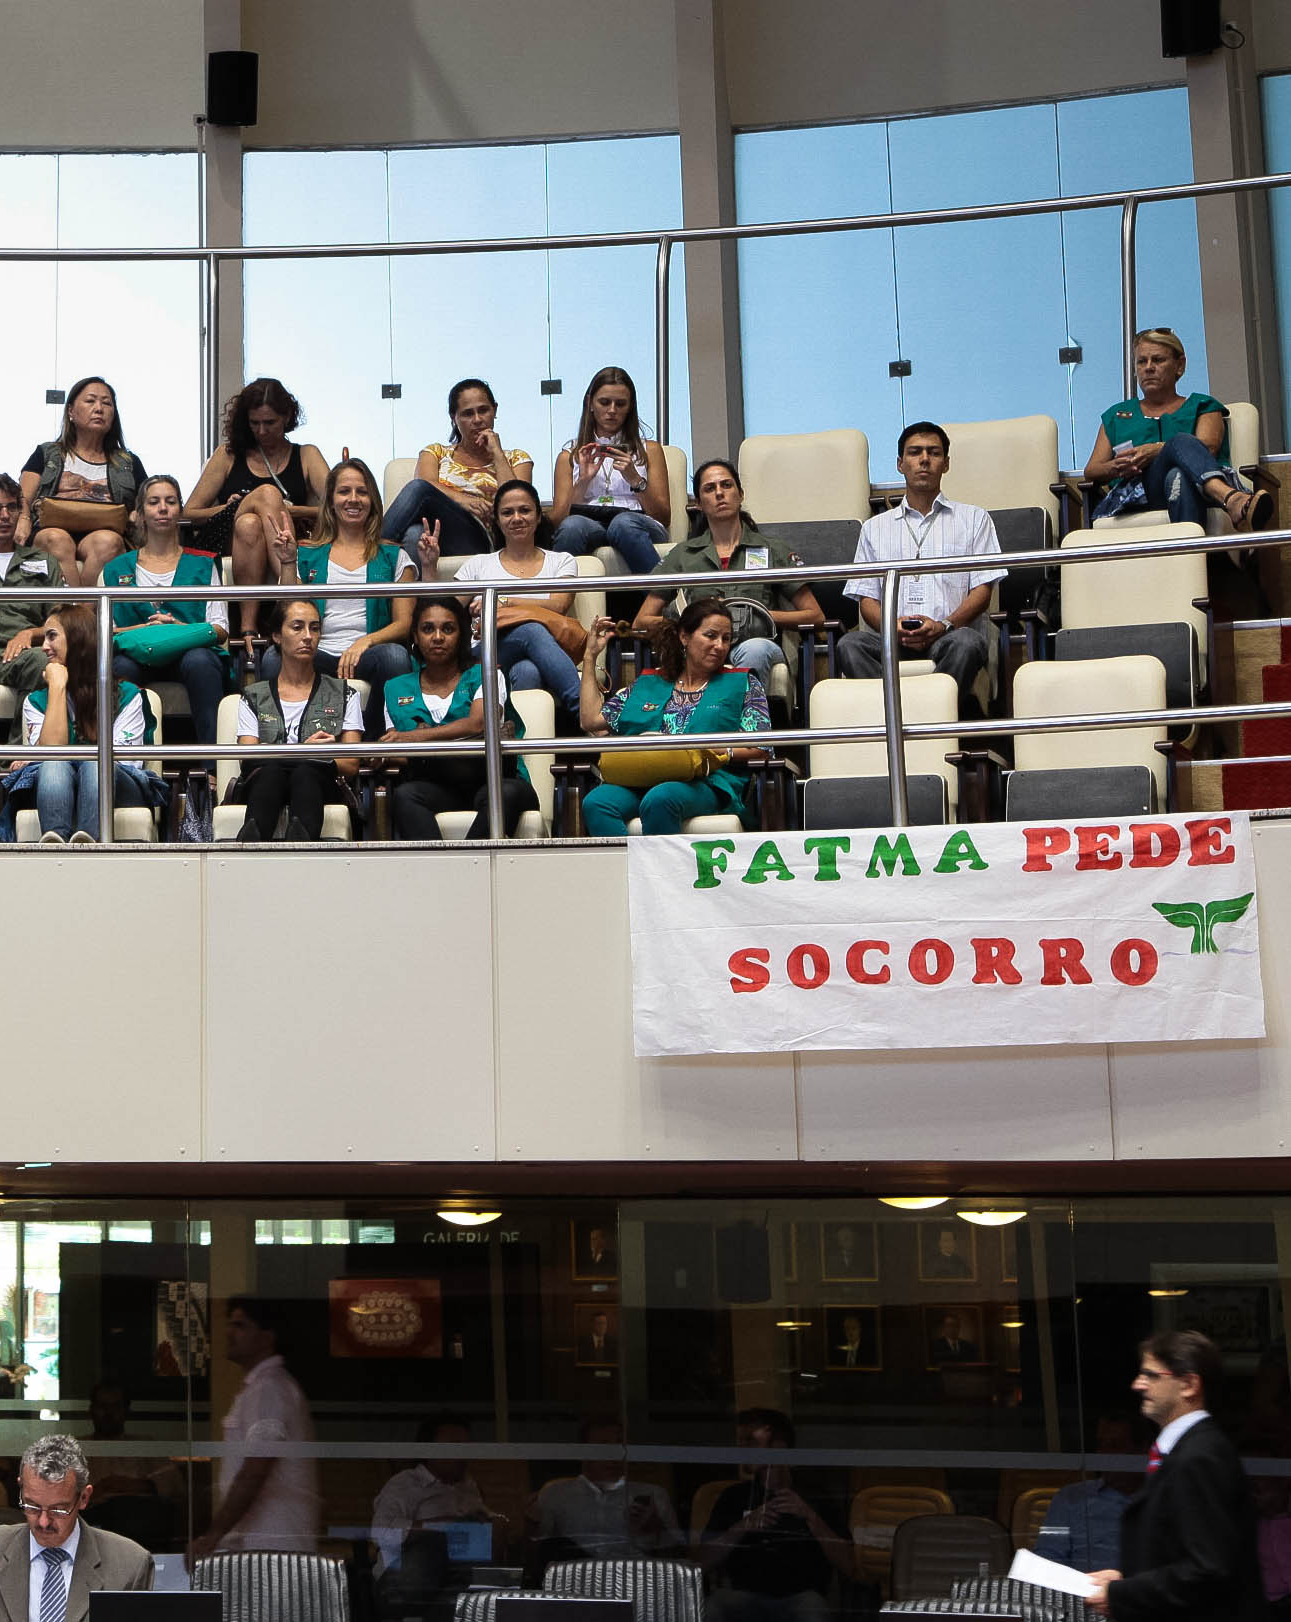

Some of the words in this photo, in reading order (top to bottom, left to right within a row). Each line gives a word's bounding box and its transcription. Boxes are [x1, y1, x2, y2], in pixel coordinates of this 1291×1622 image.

[692, 830, 989, 888] FATMA
[1022, 818, 1236, 872] PEDE
[727, 937, 1159, 993] SOCORRO
